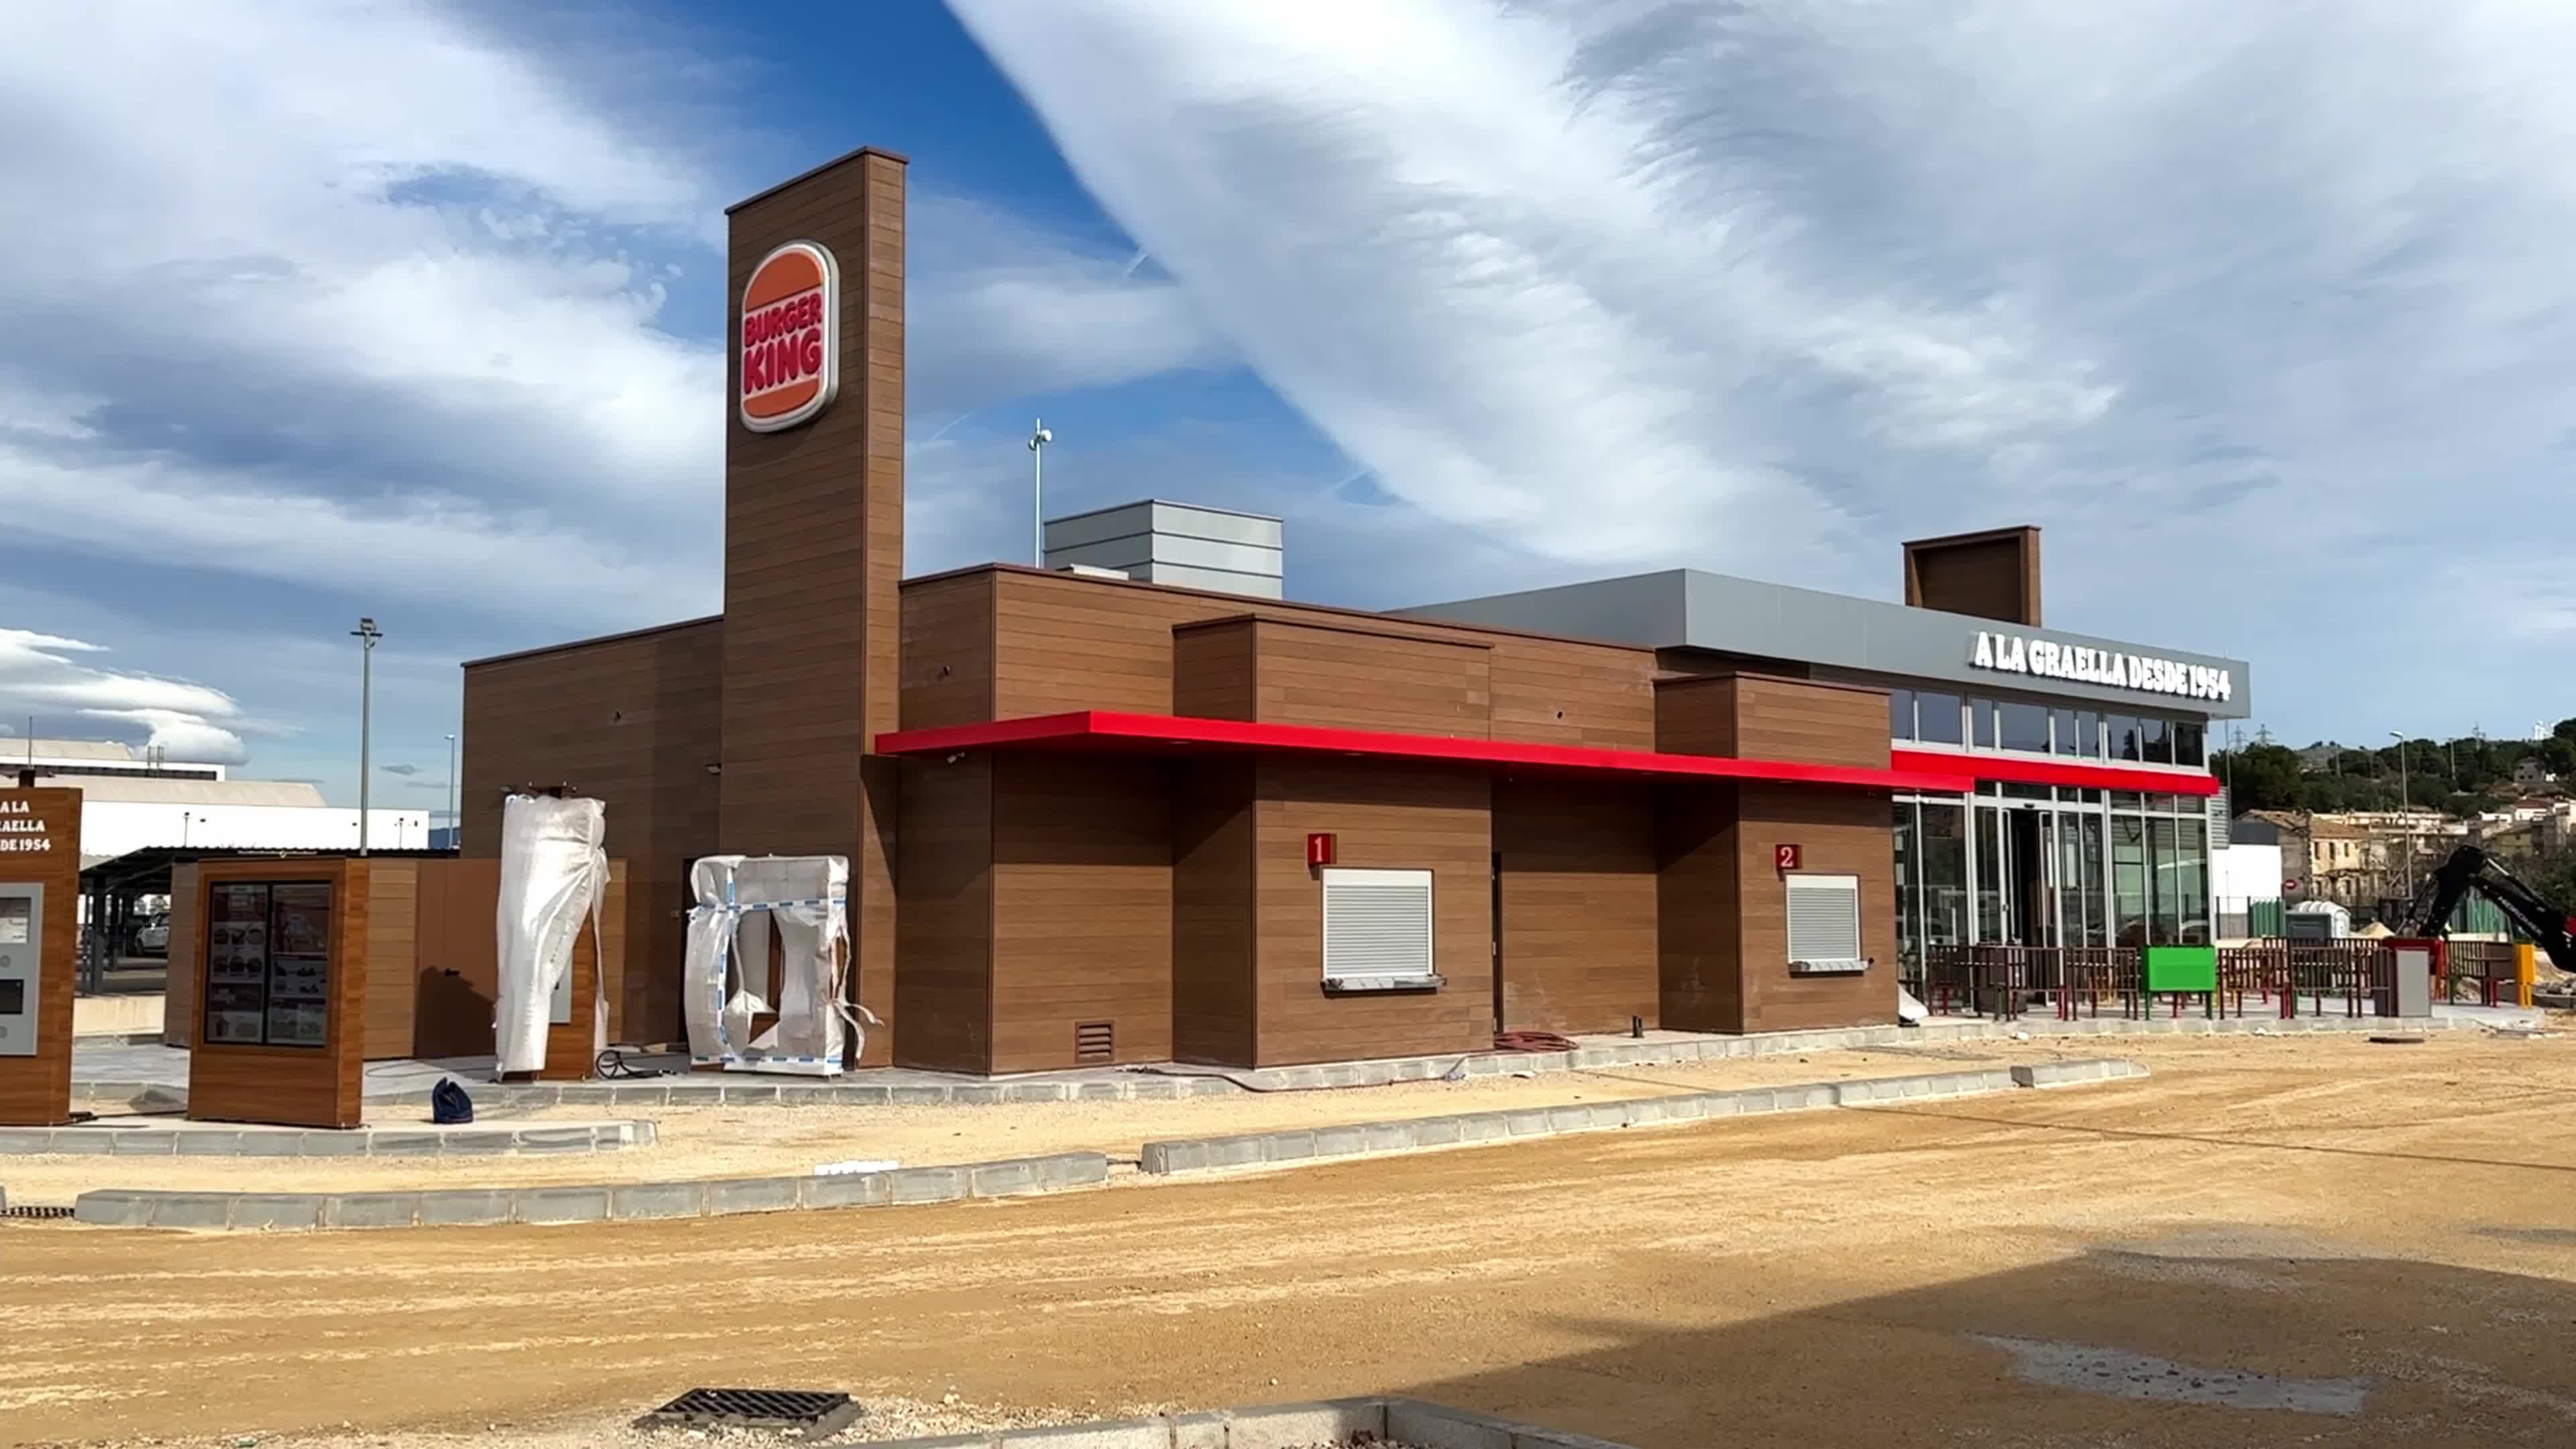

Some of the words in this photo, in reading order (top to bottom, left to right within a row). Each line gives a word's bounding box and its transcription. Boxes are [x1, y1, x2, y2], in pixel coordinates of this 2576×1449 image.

[744, 292, 822, 348] BURGER
[744, 328, 821, 394] KING
[1975, 631, 1993, 667] A
[1995, 633, 2027, 673] LA
[2029, 639, 2127, 687] GRAELLA
[2129, 655, 2188, 695] DESDE
[2189, 665, 2231, 701] 1954
[0, 800, 9, 813] A
[11, 800, 30, 813] LA
[0, 820, 45, 832] AELLA
[19, 839, 51, 851] 1954
[1314, 837, 1322, 862] 1
[1780, 847, 1793, 867] 2
